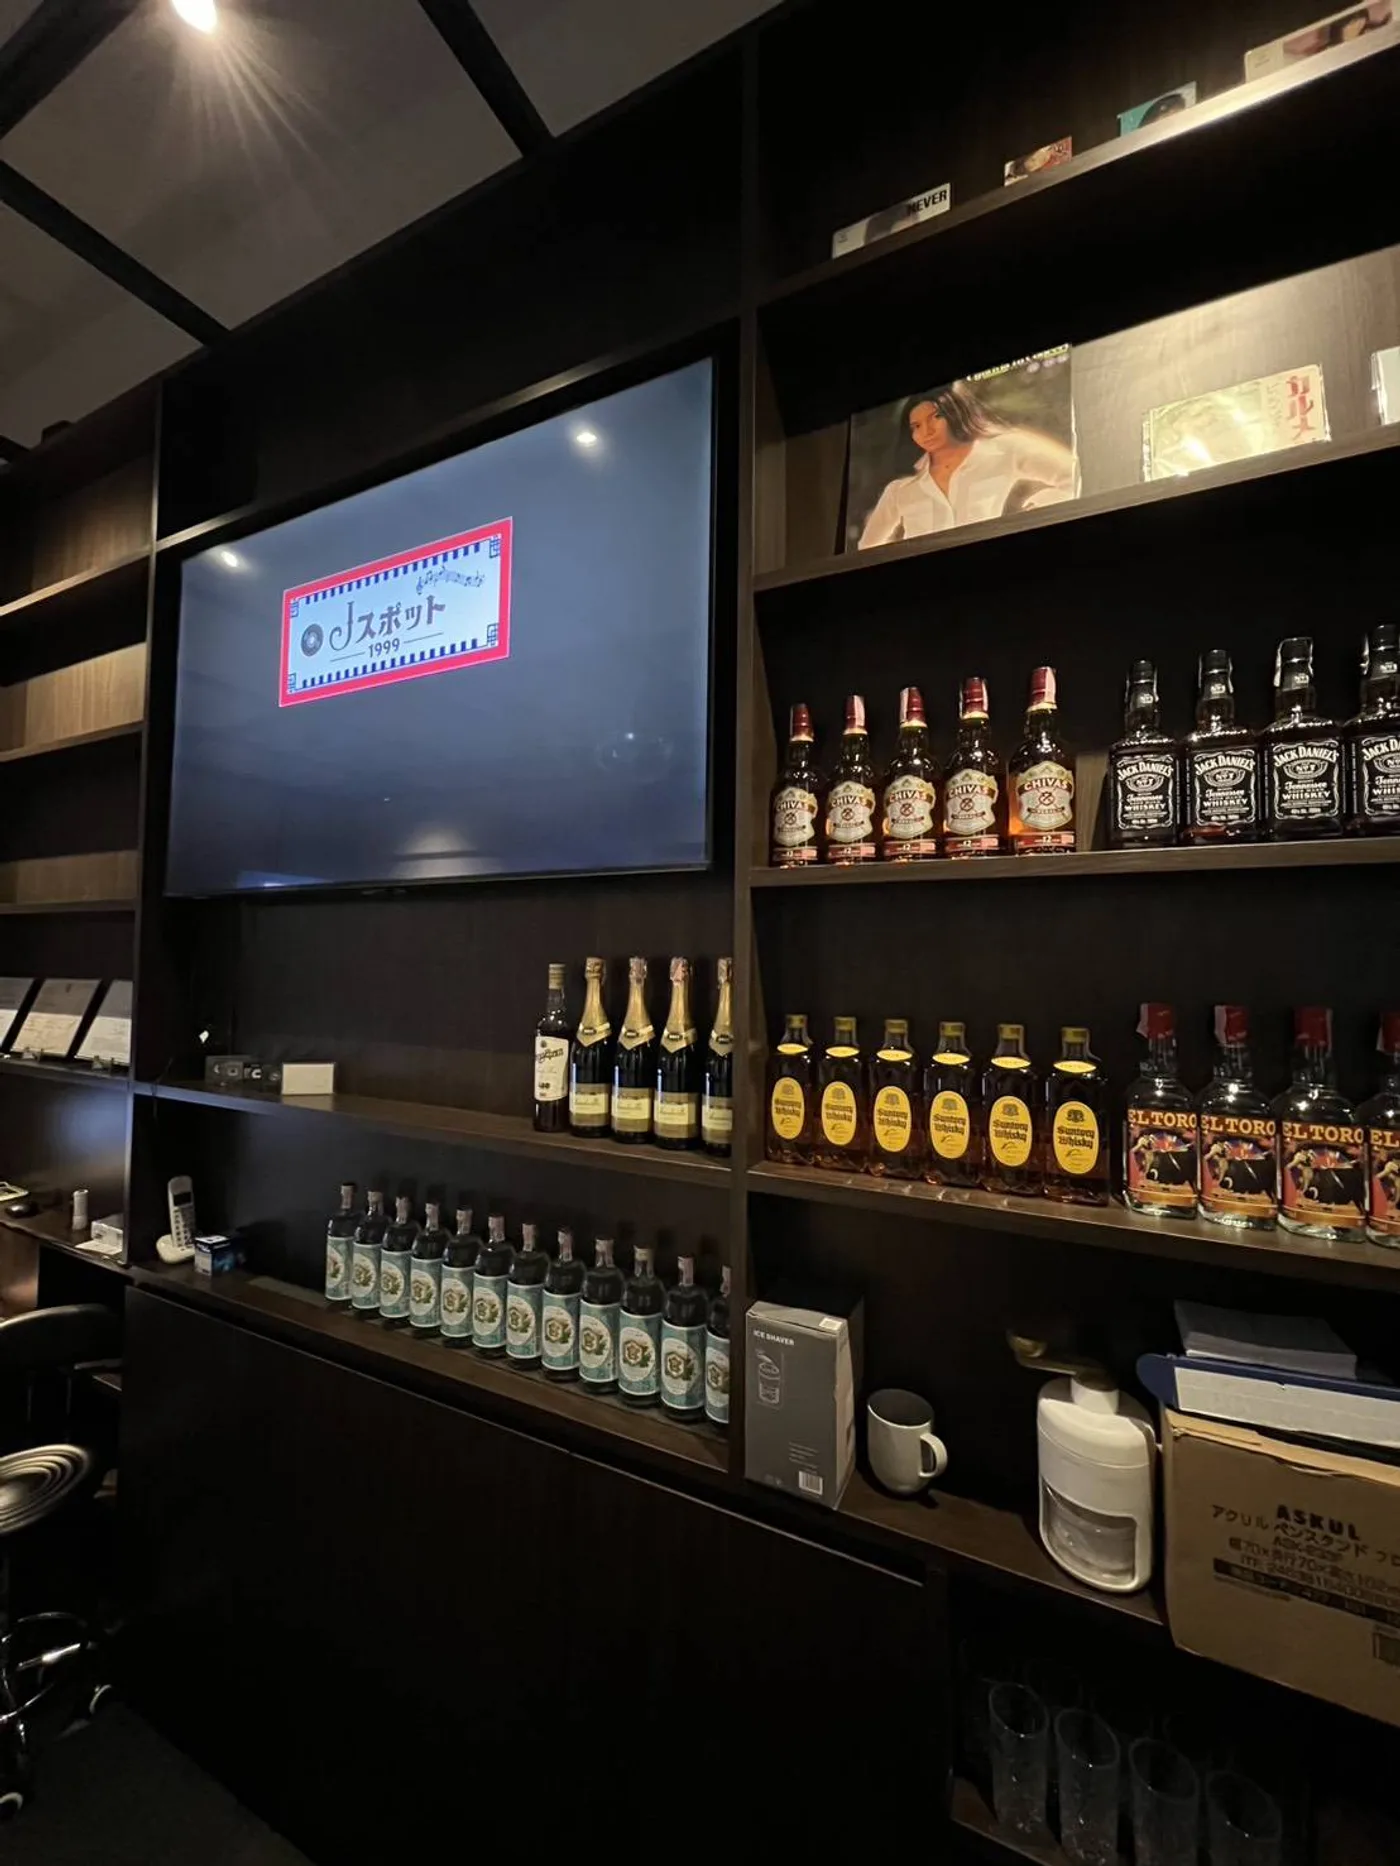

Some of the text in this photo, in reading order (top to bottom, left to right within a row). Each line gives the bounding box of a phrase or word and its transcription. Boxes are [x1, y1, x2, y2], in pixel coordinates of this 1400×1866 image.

[907, 190, 947, 214] NEVER
[329, 595, 446, 651] Jスポット
[368, 638, 400, 658] 1999
[1273, 746, 1340, 767] JACK DANIEL'S
[1362, 742, 1389, 761] JACK
[1117, 762, 1174, 781] JACK DANIEL'S
[1194, 755, 1256, 775] JACK DANIEL'S
[948, 784, 989, 798] CHIVAS
[1024, 778, 1068, 791] CHIVAS
[831, 795, 866, 807] CHIVAS
[889, 789, 926, 802] CHIVAS
[1203, 798, 1248, 807] WHISKEY
[1282, 791, 1331, 800] WHISKEY
[1124, 803, 1166, 811] WHISKEY
[1128, 1109, 1149, 1124] EL
[993, 1119, 1028, 1131] Suntory
[1057, 1126, 1095, 1139] Suntory
[1201, 1114, 1276, 1136] EL TORO
[1282, 1121, 1364, 1144] EL TORO
[994, 1129, 1027, 1142] Whisky
[1058, 1136, 1094, 1149] Whisky
[1370, 1129, 1400, 1148] EL
[766, 1333, 795, 1346] SHAVER
[1277, 1504, 1360, 1541] ASKUL
[1212, 1504, 1269, 1530] アクリル
[1274, 1522, 1369, 1558] ペンスタンド
